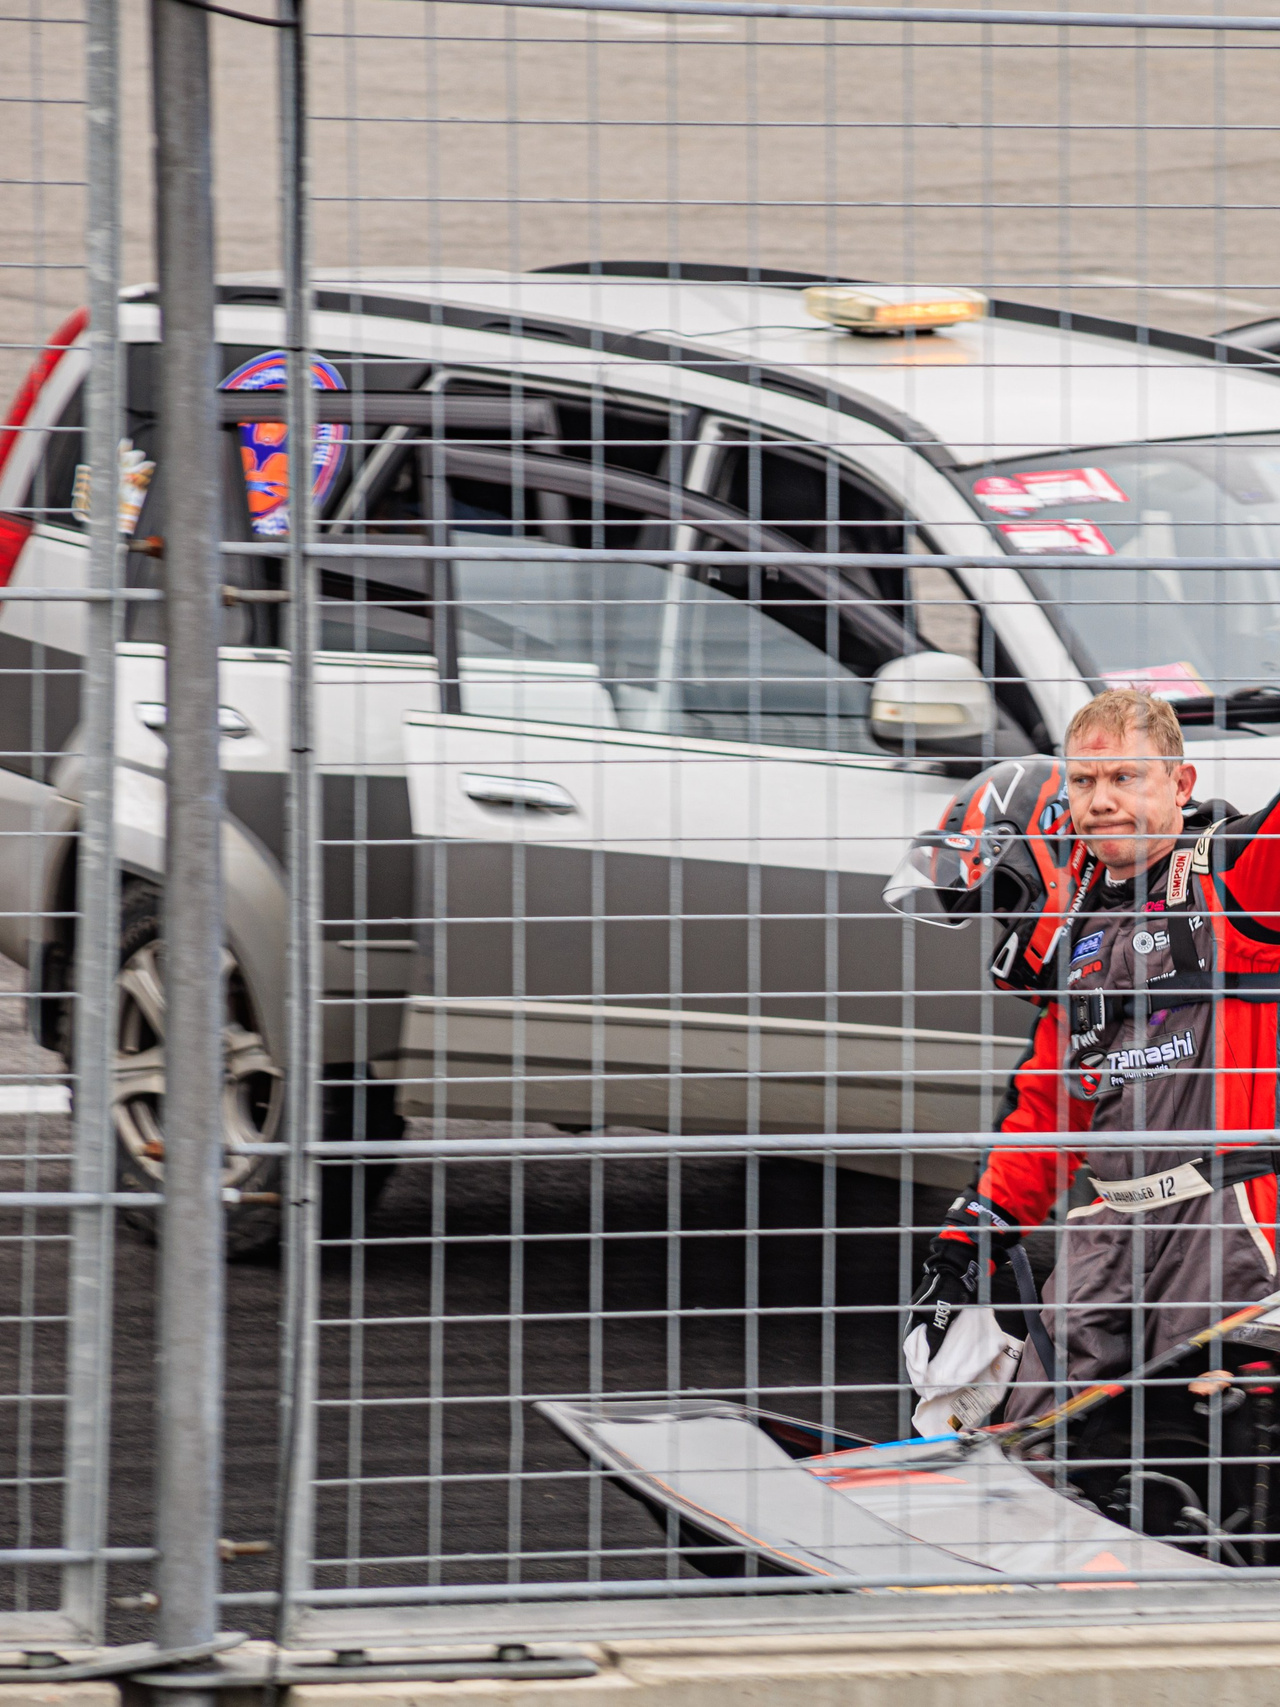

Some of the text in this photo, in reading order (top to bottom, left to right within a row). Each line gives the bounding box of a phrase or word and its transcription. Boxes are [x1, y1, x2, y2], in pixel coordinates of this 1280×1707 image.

[1171, 855, 1187, 897] SIMPSON
[1107, 1031, 1194, 1072] Tamashi
[1158, 1175, 1176, 1199] 12
